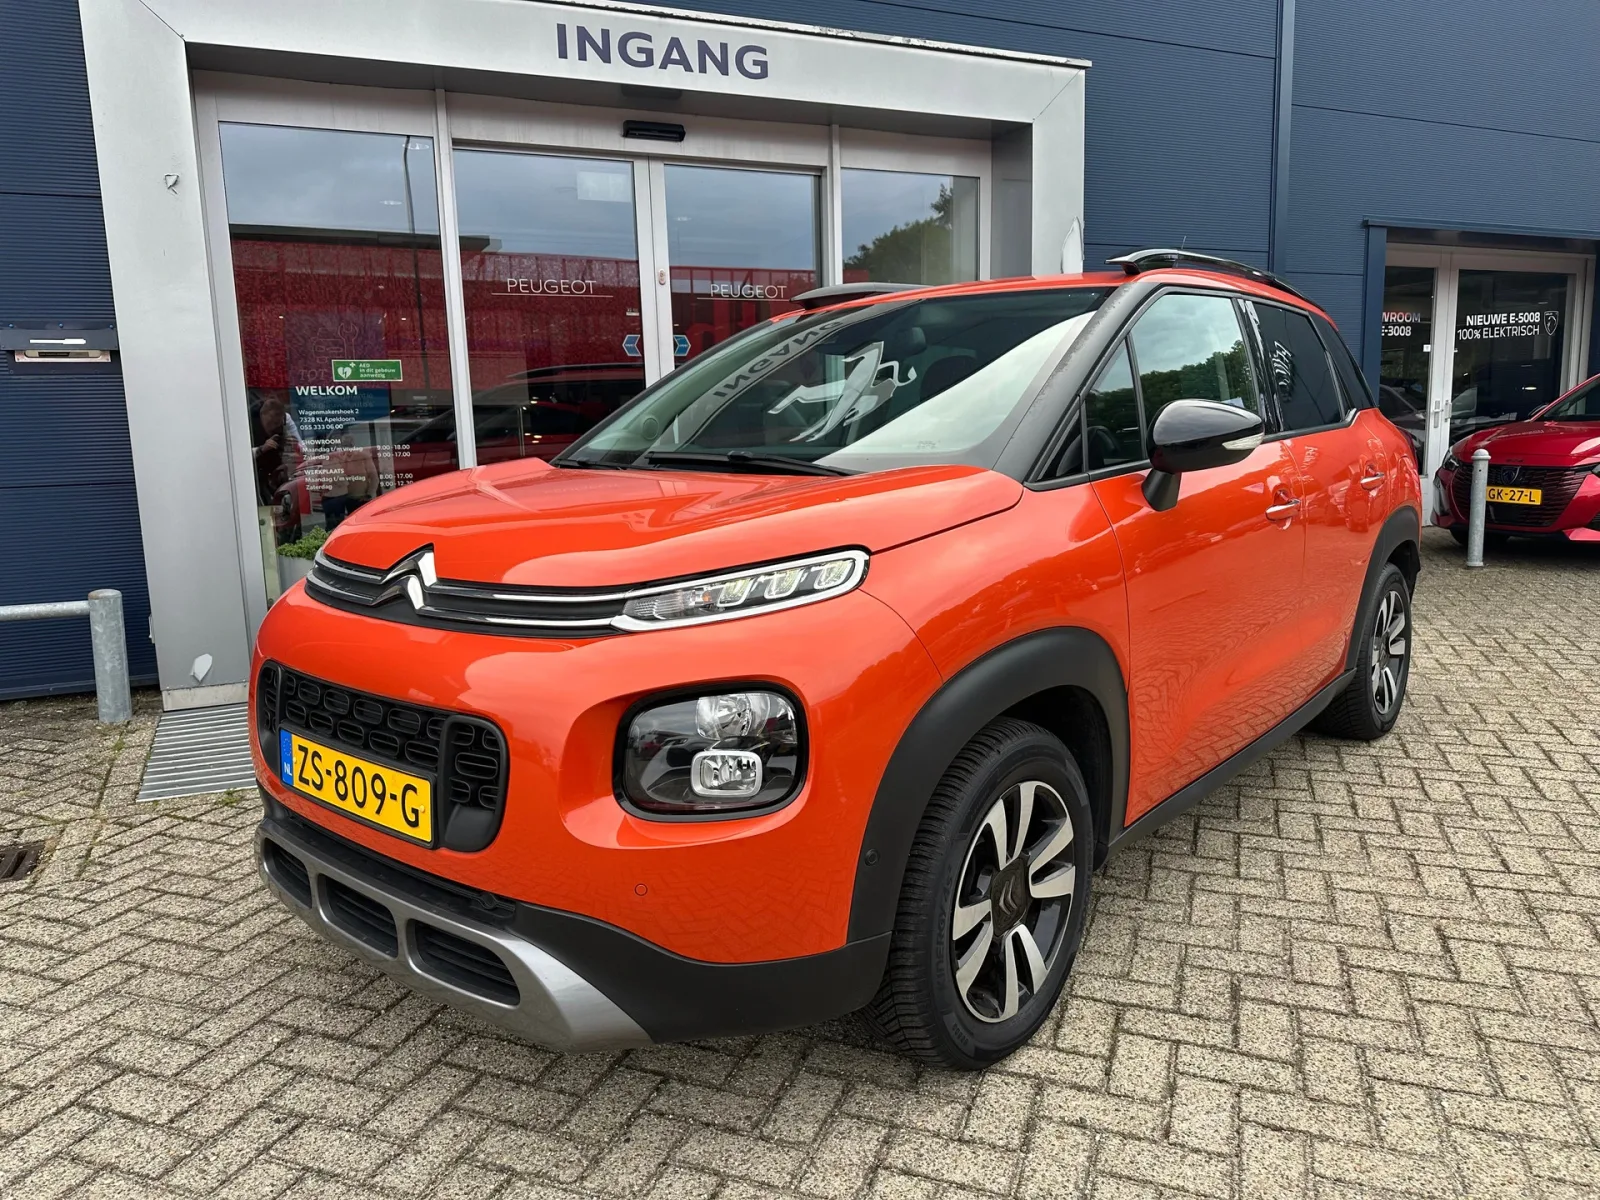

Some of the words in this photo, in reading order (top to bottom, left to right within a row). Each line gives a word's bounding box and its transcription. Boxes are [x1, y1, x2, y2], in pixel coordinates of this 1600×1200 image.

[556, 23, 769, 80] INGANG
[506, 278, 597, 294] PEUGEOT
[710, 283, 787, 299] PEUGEOT
[1466, 313, 1508, 326] NIEUWE
[1509, 311, 1541, 323] E-5008
[1457, 328, 1481, 340] 100%
[1482, 325, 1540, 339] ELEKTRISCH
[295, 385, 358, 396] WELKOM
[283, 762, 293, 777] NL
[297, 744, 420, 828] ZS-809-G
